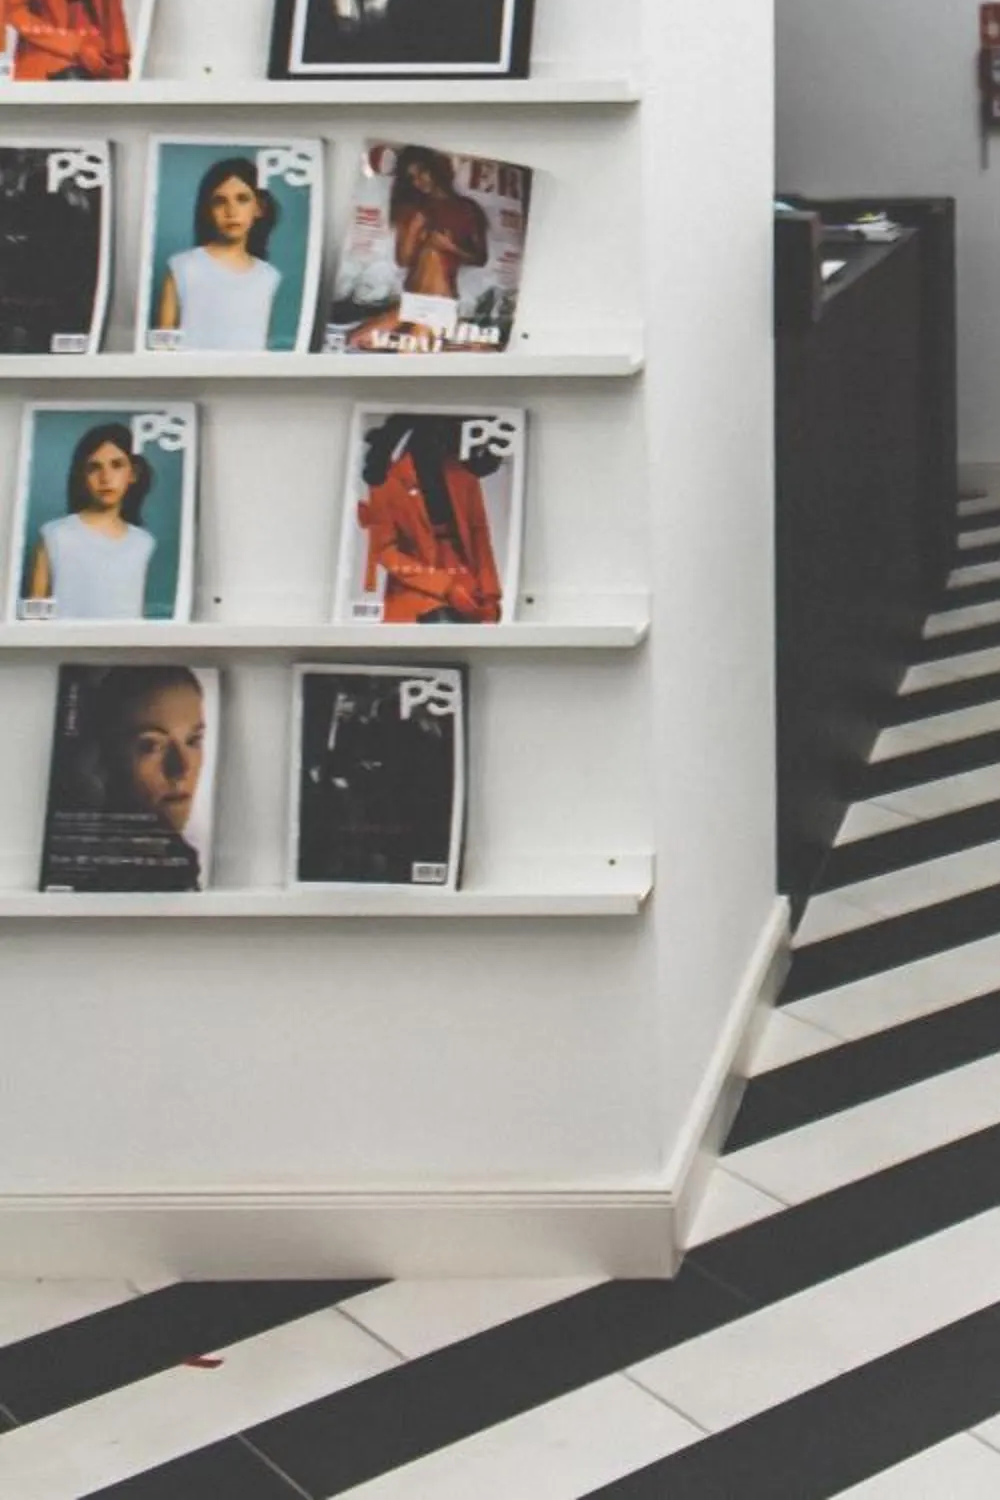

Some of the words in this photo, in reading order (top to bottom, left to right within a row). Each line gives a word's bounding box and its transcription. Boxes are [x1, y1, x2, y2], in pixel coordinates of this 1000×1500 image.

[47, 148, 105, 193] PS
[256, 147, 314, 189] PS
[131, 411, 188, 454] PS
[460, 416, 518, 461] PS
[400, 675, 457, 719] PS
